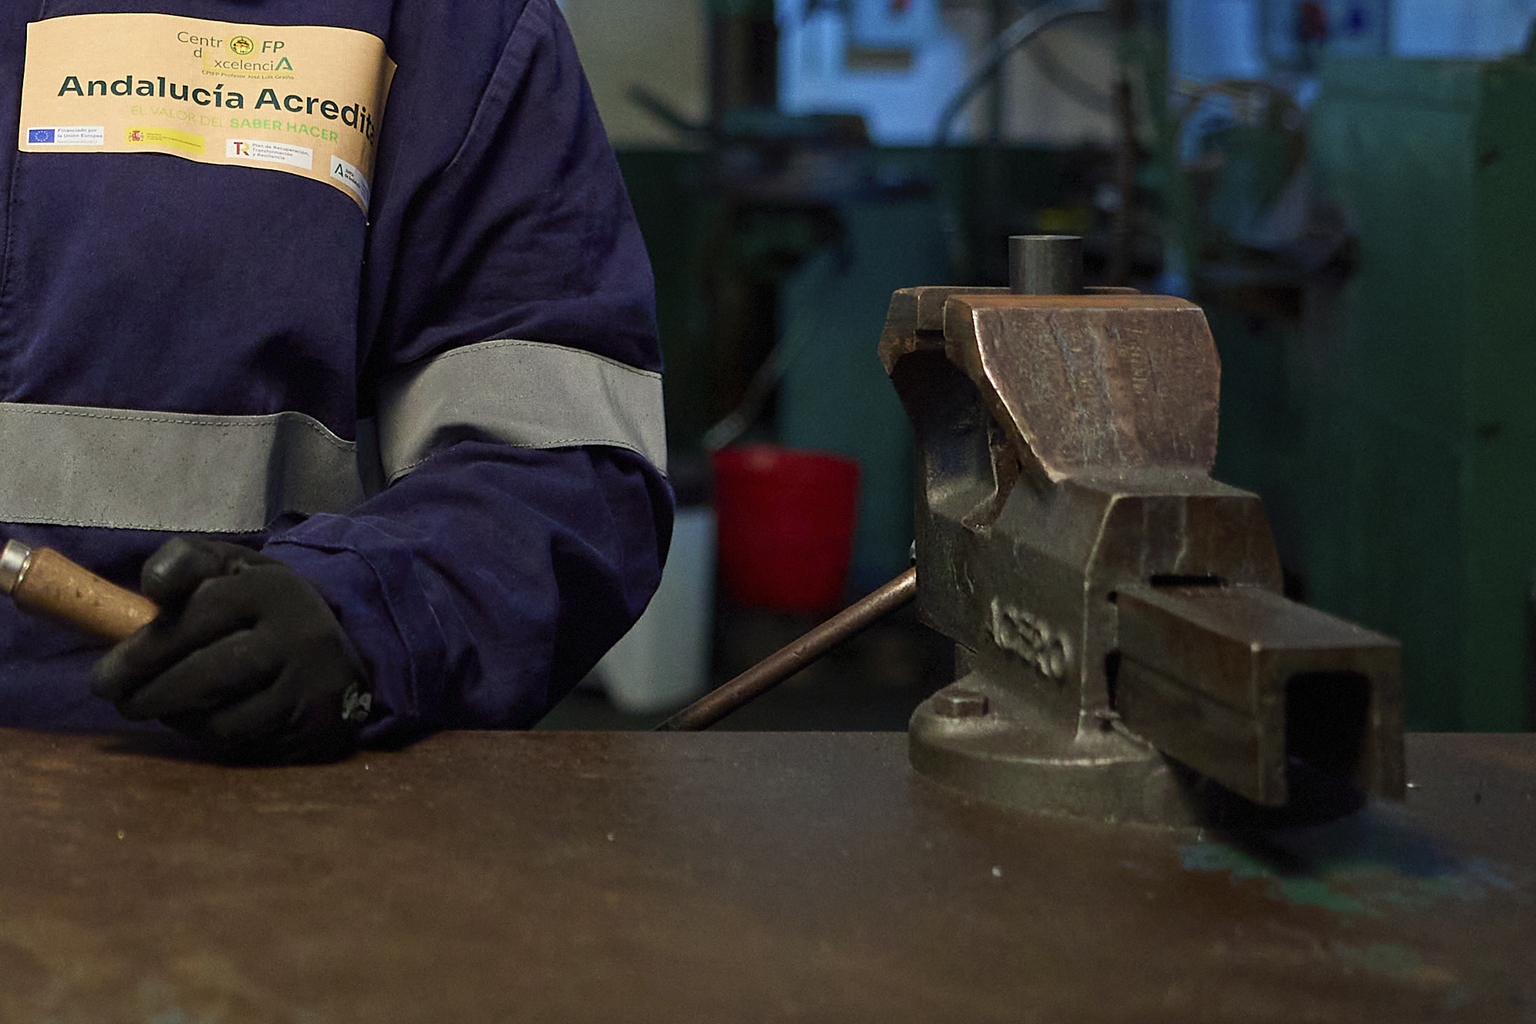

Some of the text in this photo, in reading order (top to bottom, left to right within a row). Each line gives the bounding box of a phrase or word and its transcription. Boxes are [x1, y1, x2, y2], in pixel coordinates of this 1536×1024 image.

[261, 40, 285, 54] FP
[57, 75, 244, 110] Andalucía
[131, 106, 339, 143] EL VALOR DEL SABER HACER
